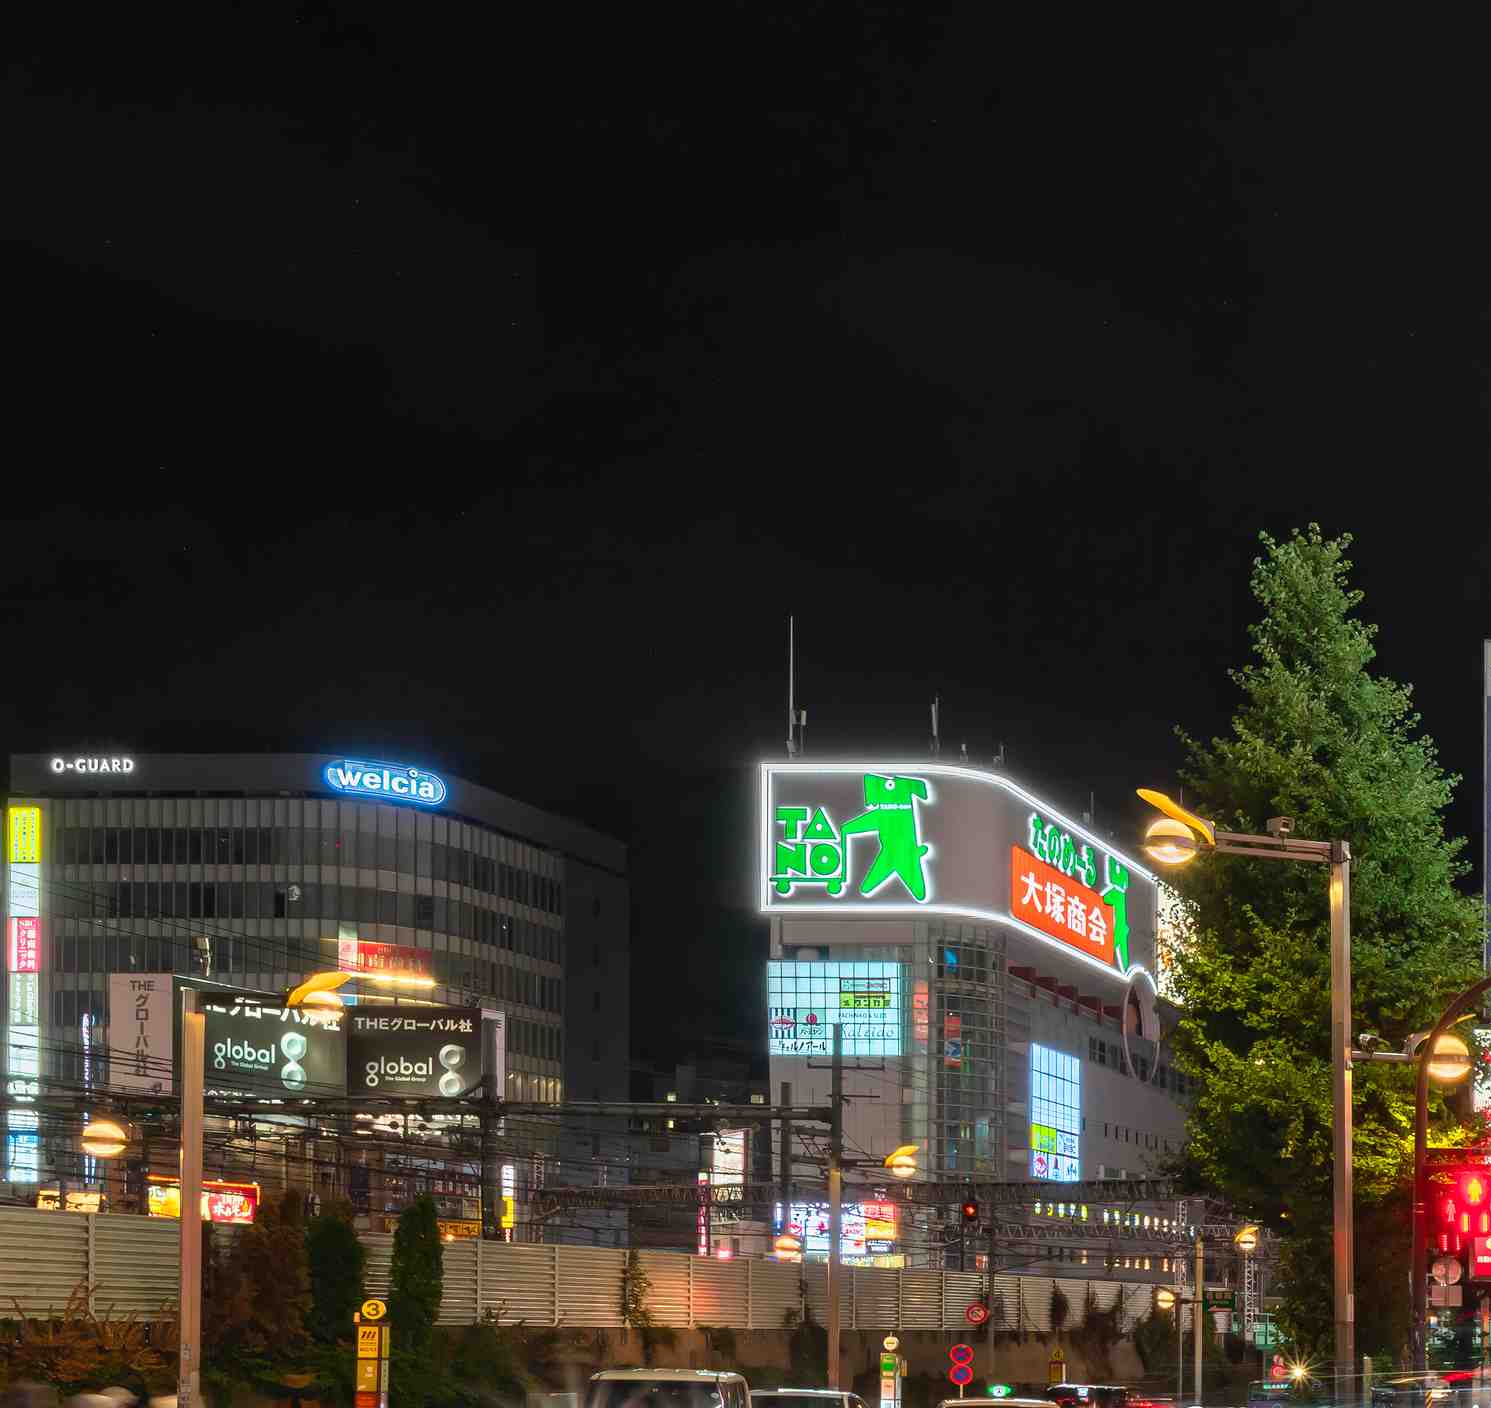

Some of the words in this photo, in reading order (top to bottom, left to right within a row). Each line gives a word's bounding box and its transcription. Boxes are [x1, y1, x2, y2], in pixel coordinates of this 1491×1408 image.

[52, 758, 135, 773] O-GUARD
[336, 765, 435, 800] welcia
[775, 806, 837, 840] TA
[775, 841, 842, 876] NO
[1029, 812, 1097, 887] たのめーる
[1018, 871, 1108, 946] 大塚商会
[213, 1040, 276, 1071] global
[365, 1056, 434, 1087] global
[366, 1302, 380, 1316] 3
